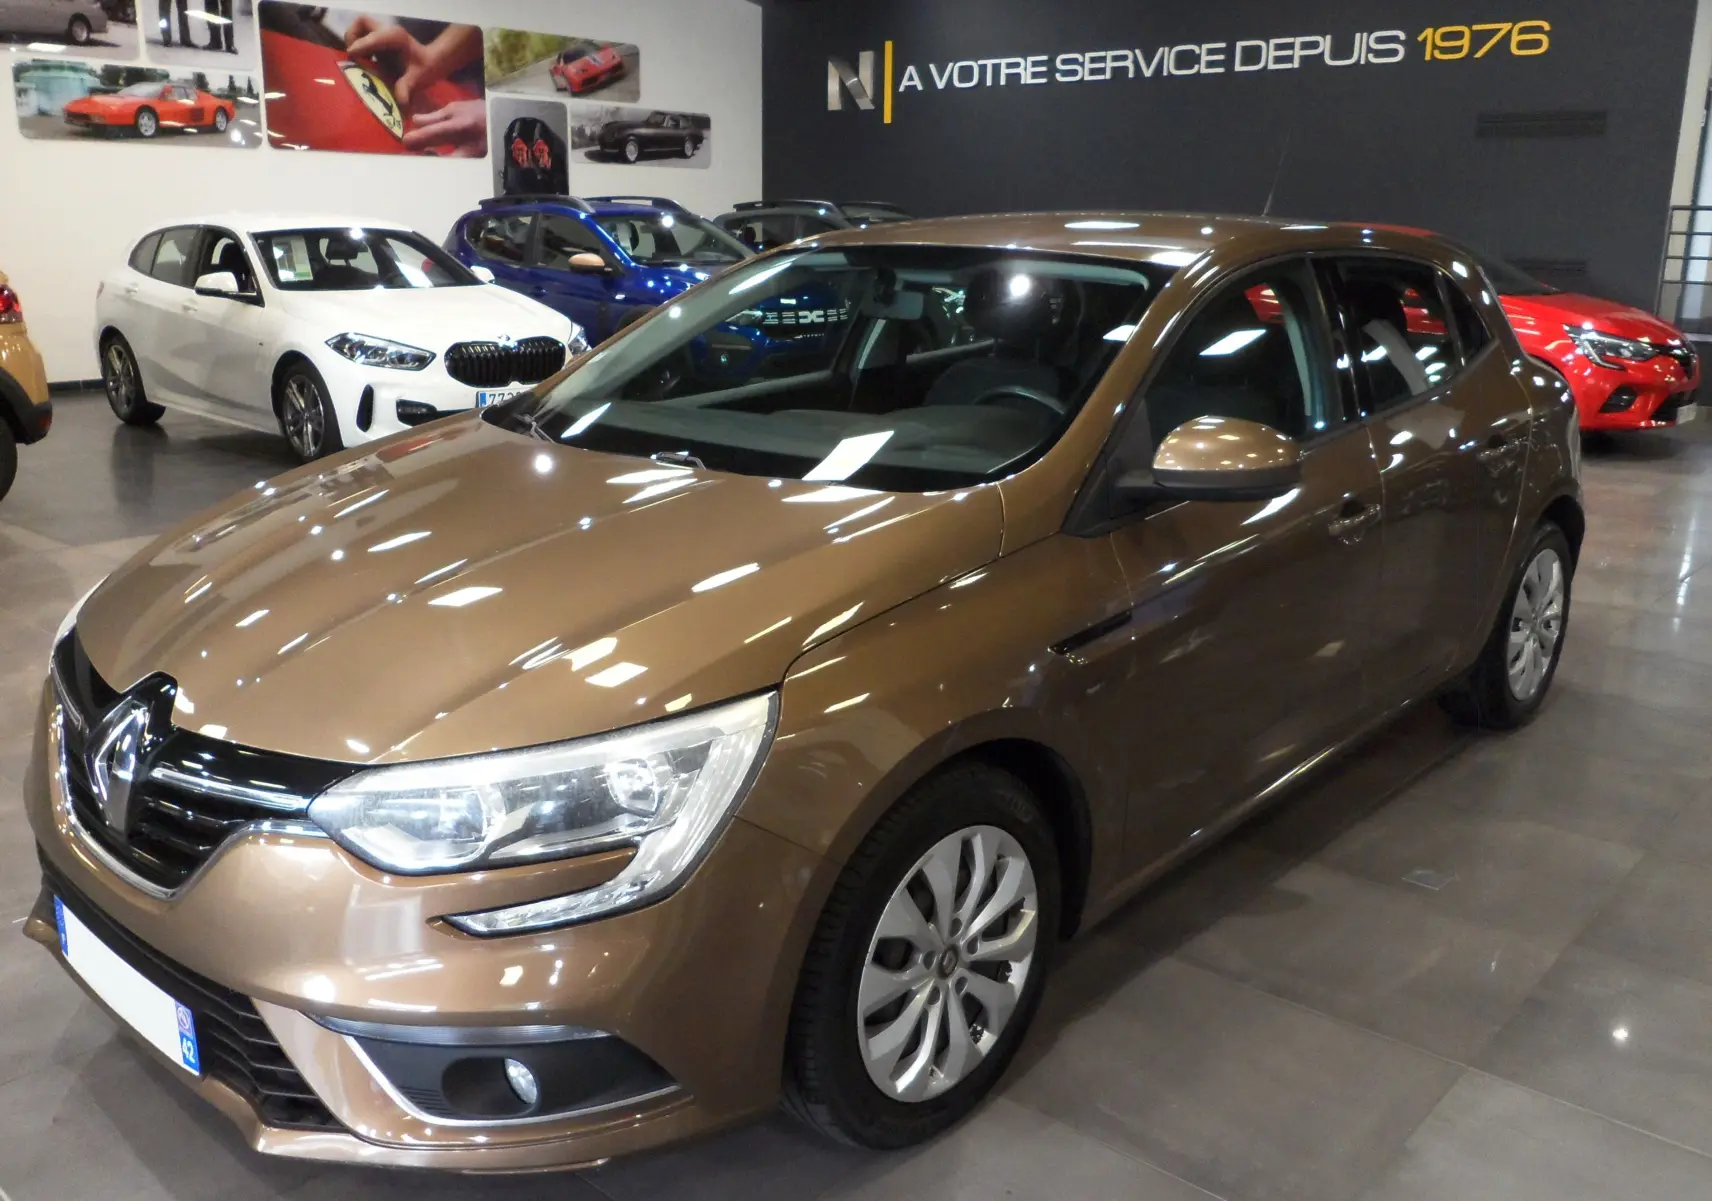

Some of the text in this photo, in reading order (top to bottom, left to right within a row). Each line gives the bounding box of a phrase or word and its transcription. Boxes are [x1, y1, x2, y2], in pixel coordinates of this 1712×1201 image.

[826, 50, 876, 111] N
[898, 20, 1552, 92] A VOTRE SERVICE DEPUIS 1976
[182, 1037, 196, 1064] 42
